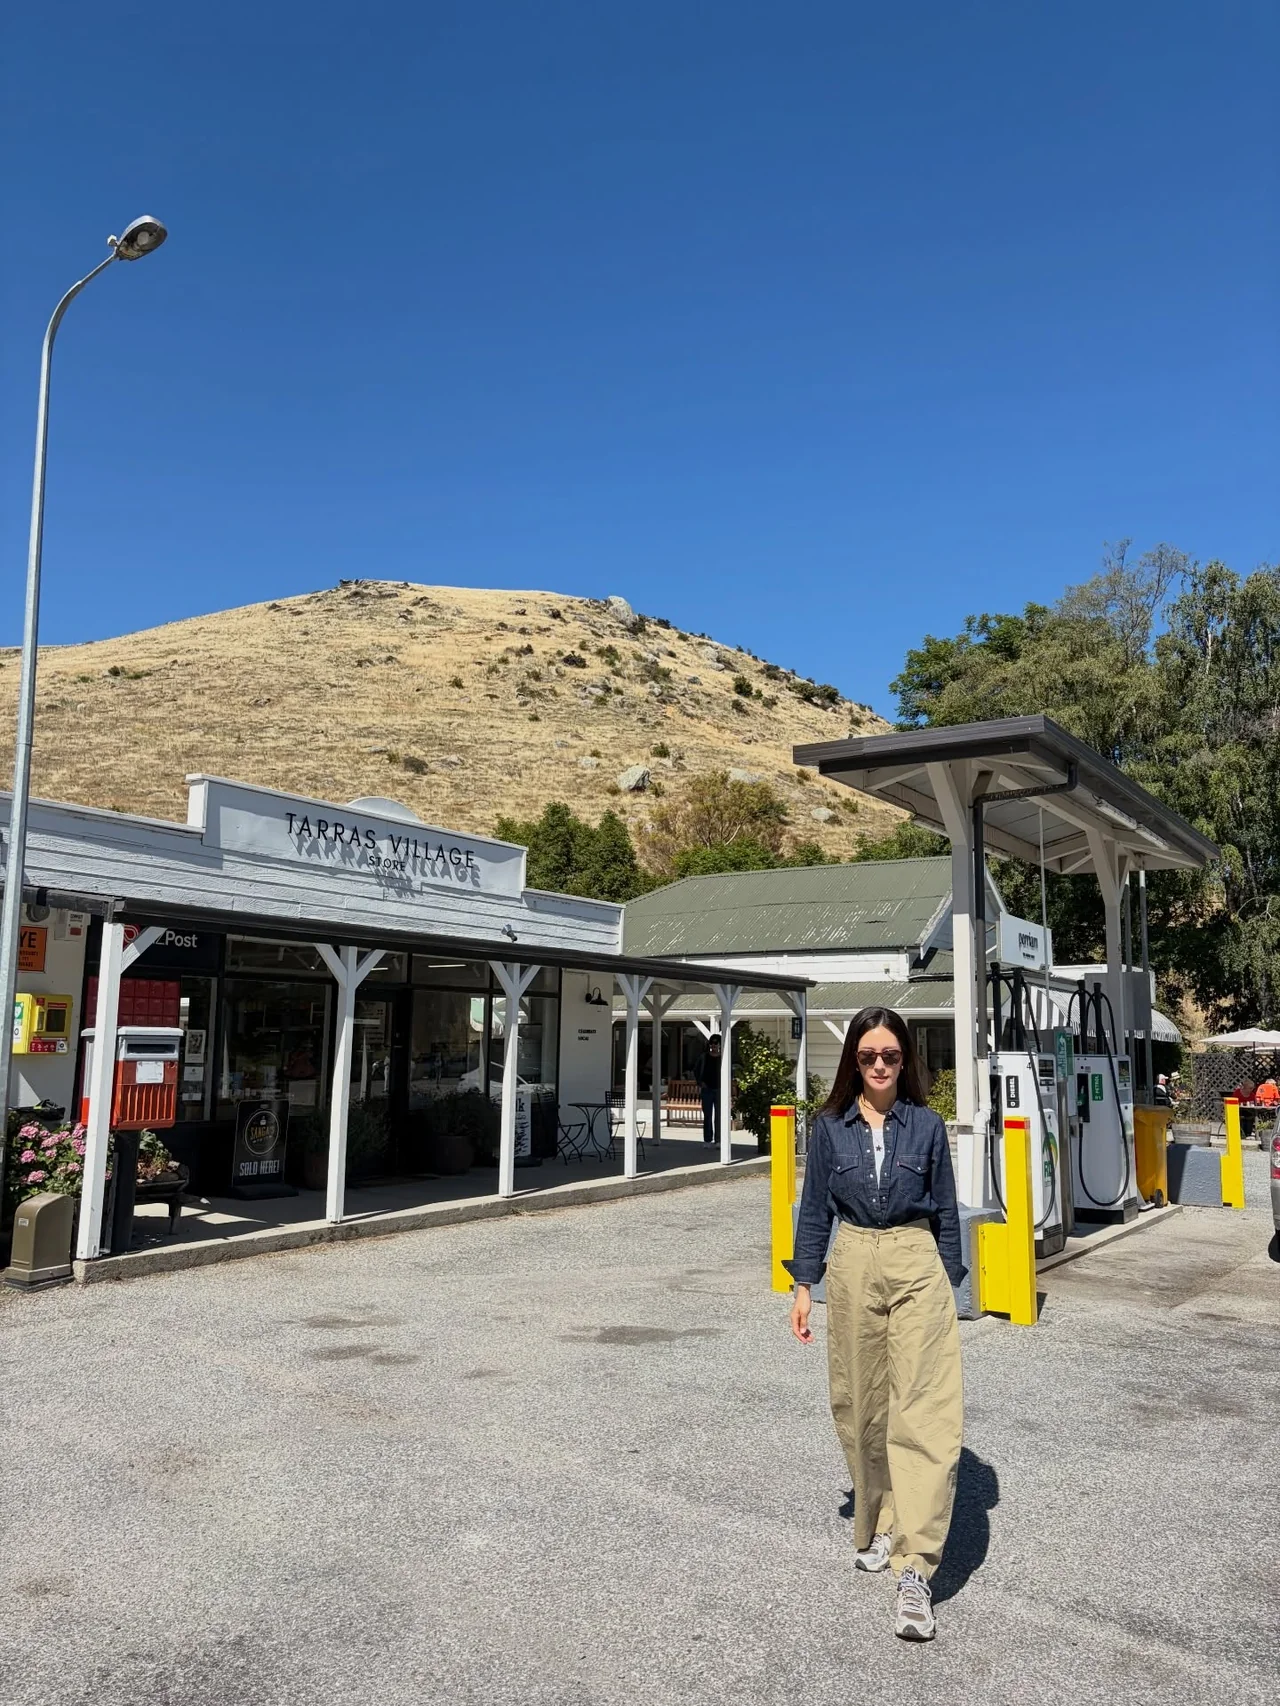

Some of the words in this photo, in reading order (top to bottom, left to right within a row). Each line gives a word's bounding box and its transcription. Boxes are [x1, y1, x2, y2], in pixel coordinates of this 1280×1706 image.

[285, 812, 376, 849] TARRAS
[389, 833, 475, 868] VILLAGE
[368, 855, 406, 871] STORE
[239, 1161, 258, 1176] SOLD
[260, 1160, 280, 1174] HERE!
